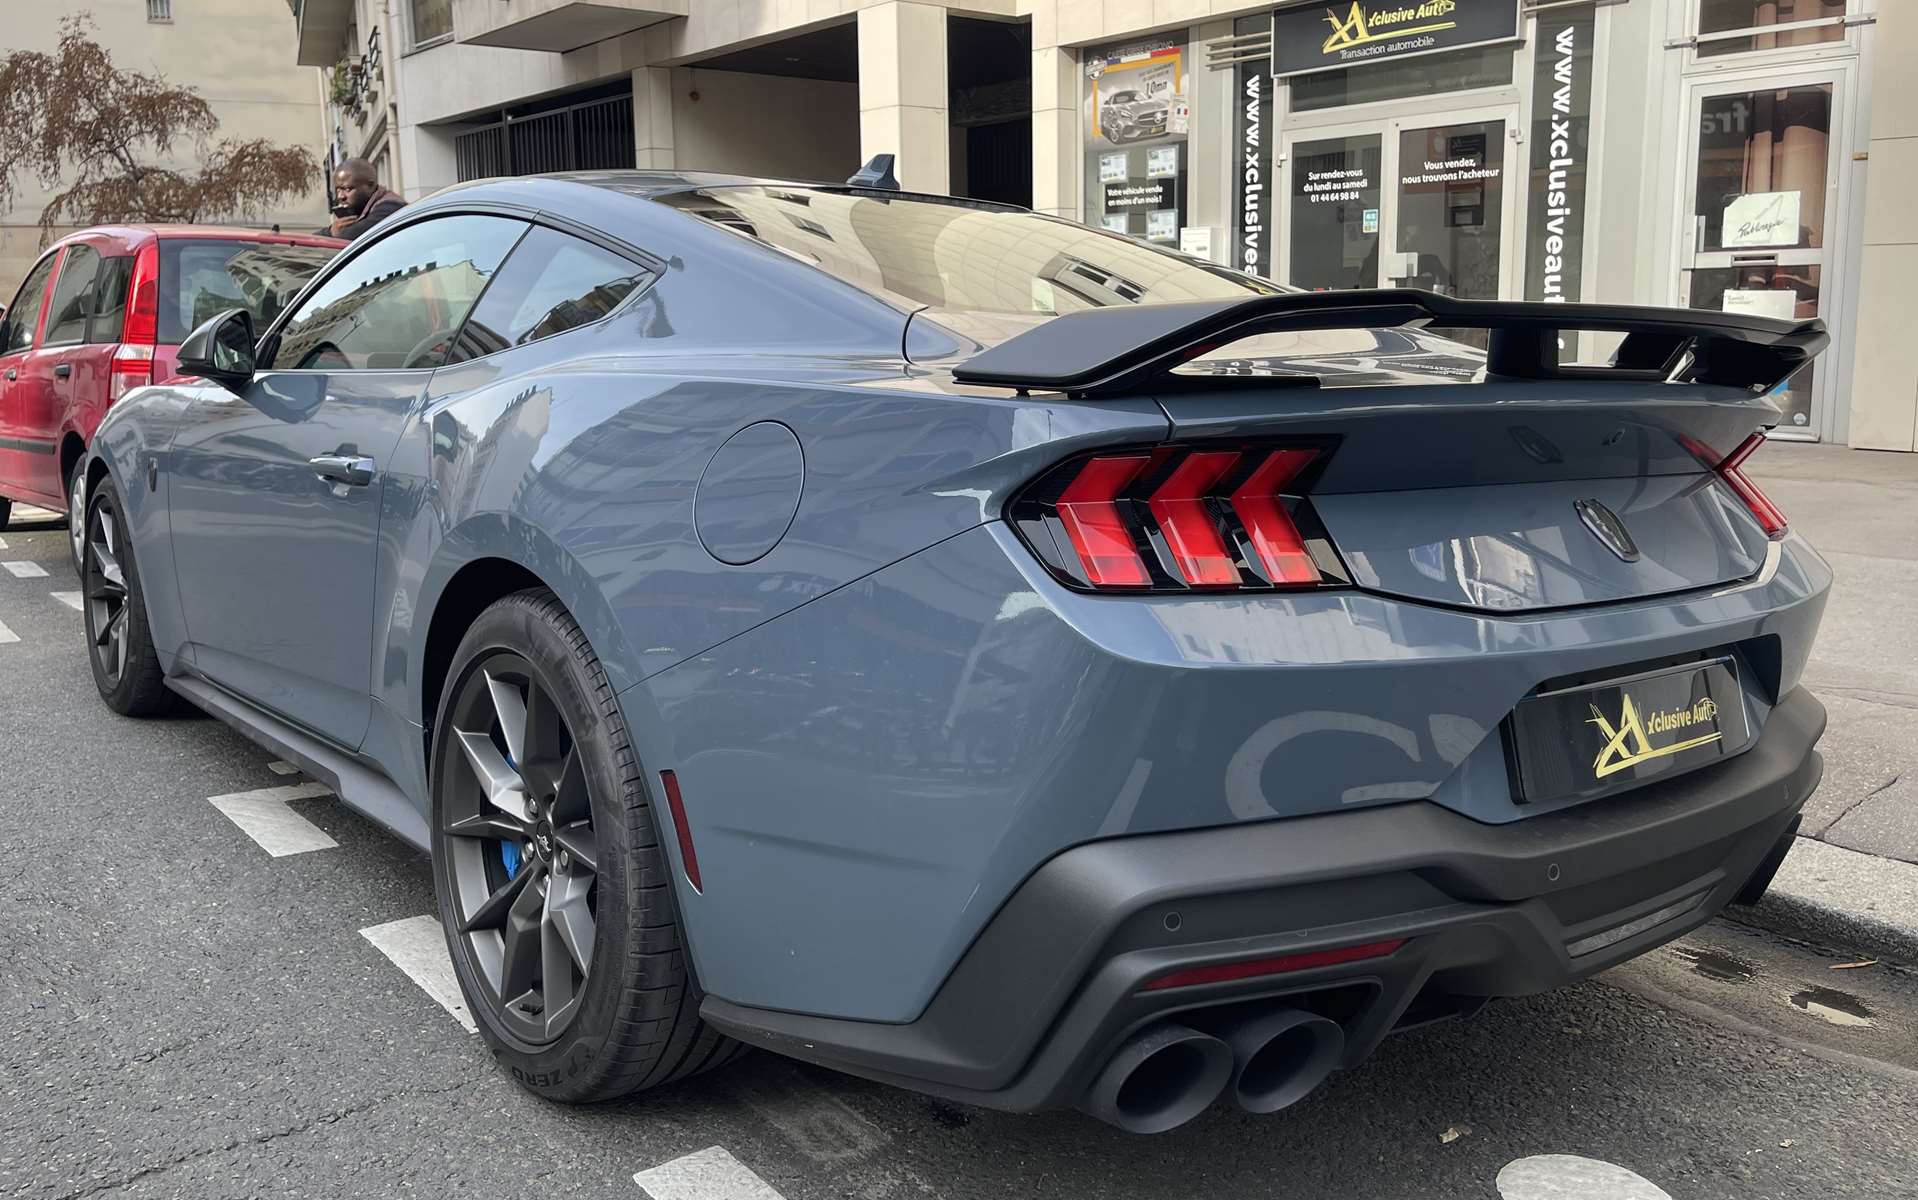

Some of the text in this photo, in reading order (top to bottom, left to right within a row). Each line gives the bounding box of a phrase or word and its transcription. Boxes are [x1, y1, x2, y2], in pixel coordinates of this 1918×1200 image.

[1340, 36, 1435, 60] Transaction automobile
[1424, 158, 1476, 171] Vous vendez,
[1308, 169, 1363, 180] Sur rendez-vous
[1402, 169, 1500, 185] nous trouvons l'acheteur
[1107, 185, 1163, 197] Votre véhicule vendu
[1303, 183, 1313, 192] du
[1313, 182, 1331, 191] lundi
[1342, 178, 1368, 189] samedi
[1116, 198, 1132, 206] moins
[1132, 196, 1145, 205] d'un
[1310, 191, 1359, 202] 01 44 64 98 84
[512, 1066, 563, 1088] ZERO
